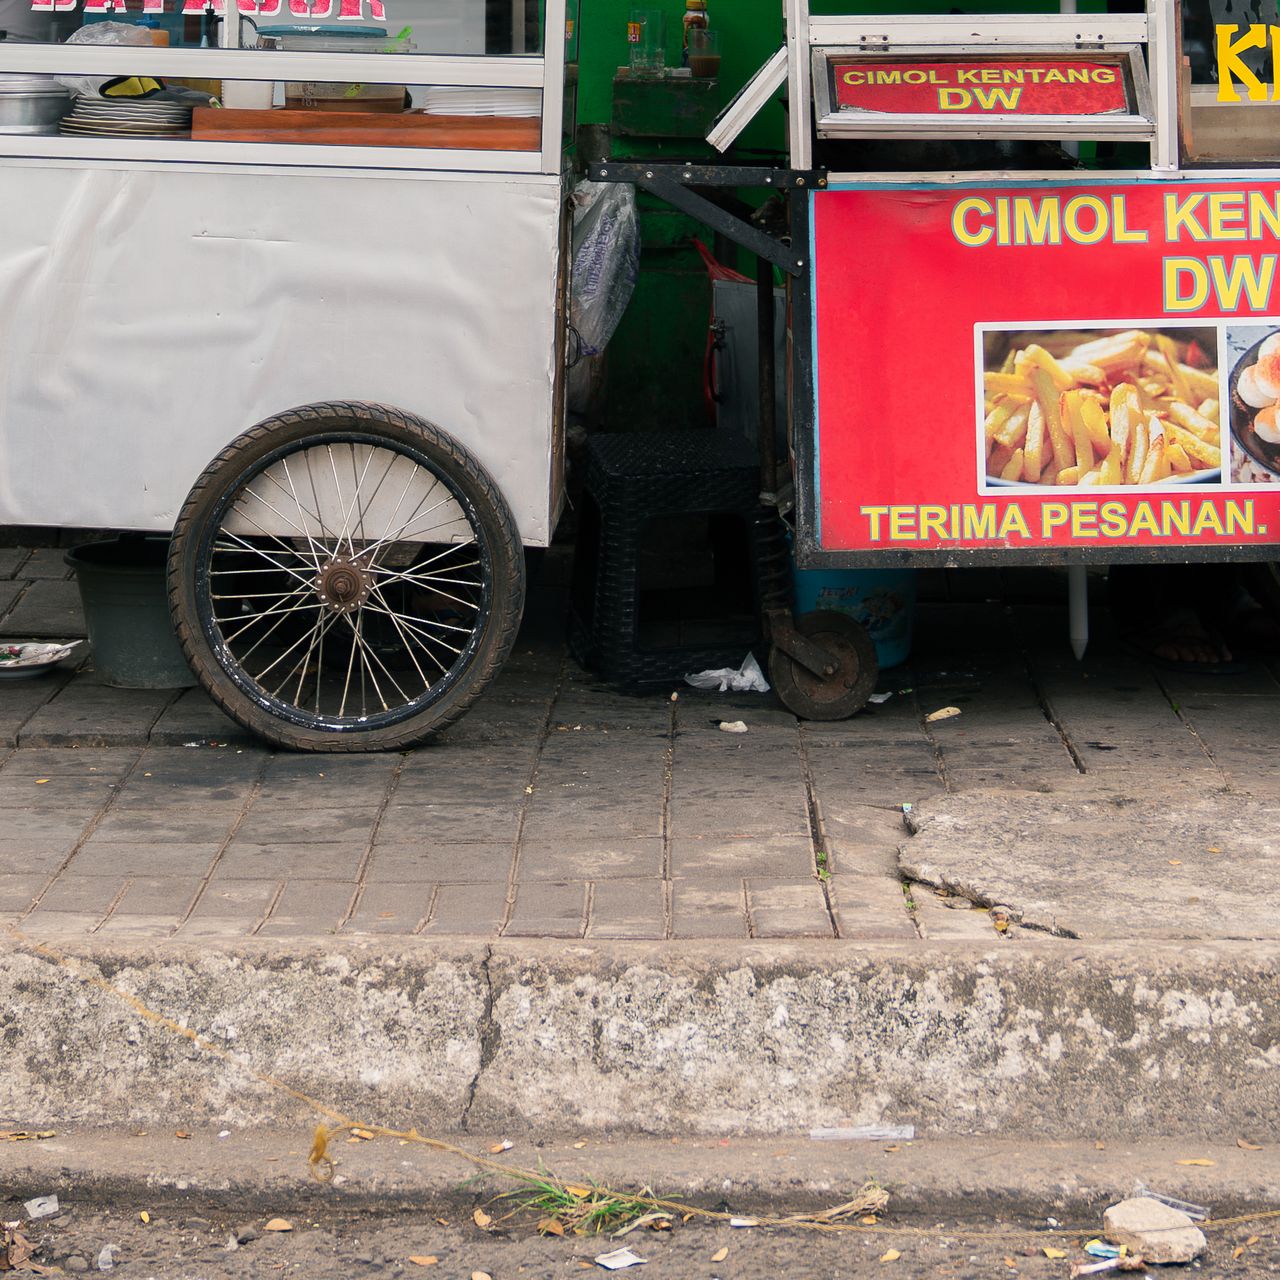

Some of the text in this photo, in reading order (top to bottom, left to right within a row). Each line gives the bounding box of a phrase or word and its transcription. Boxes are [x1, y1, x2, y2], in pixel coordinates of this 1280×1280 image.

[843, 68, 1117, 86] CIMOL KENTANG
[937, 87, 1022, 111] DW
[951, 195, 1146, 246] CIMOL
[1162, 254, 1277, 313] DW
[860, 505, 1030, 542] TERIMA
[1040, 500, 1269, 540] PESANAN.
